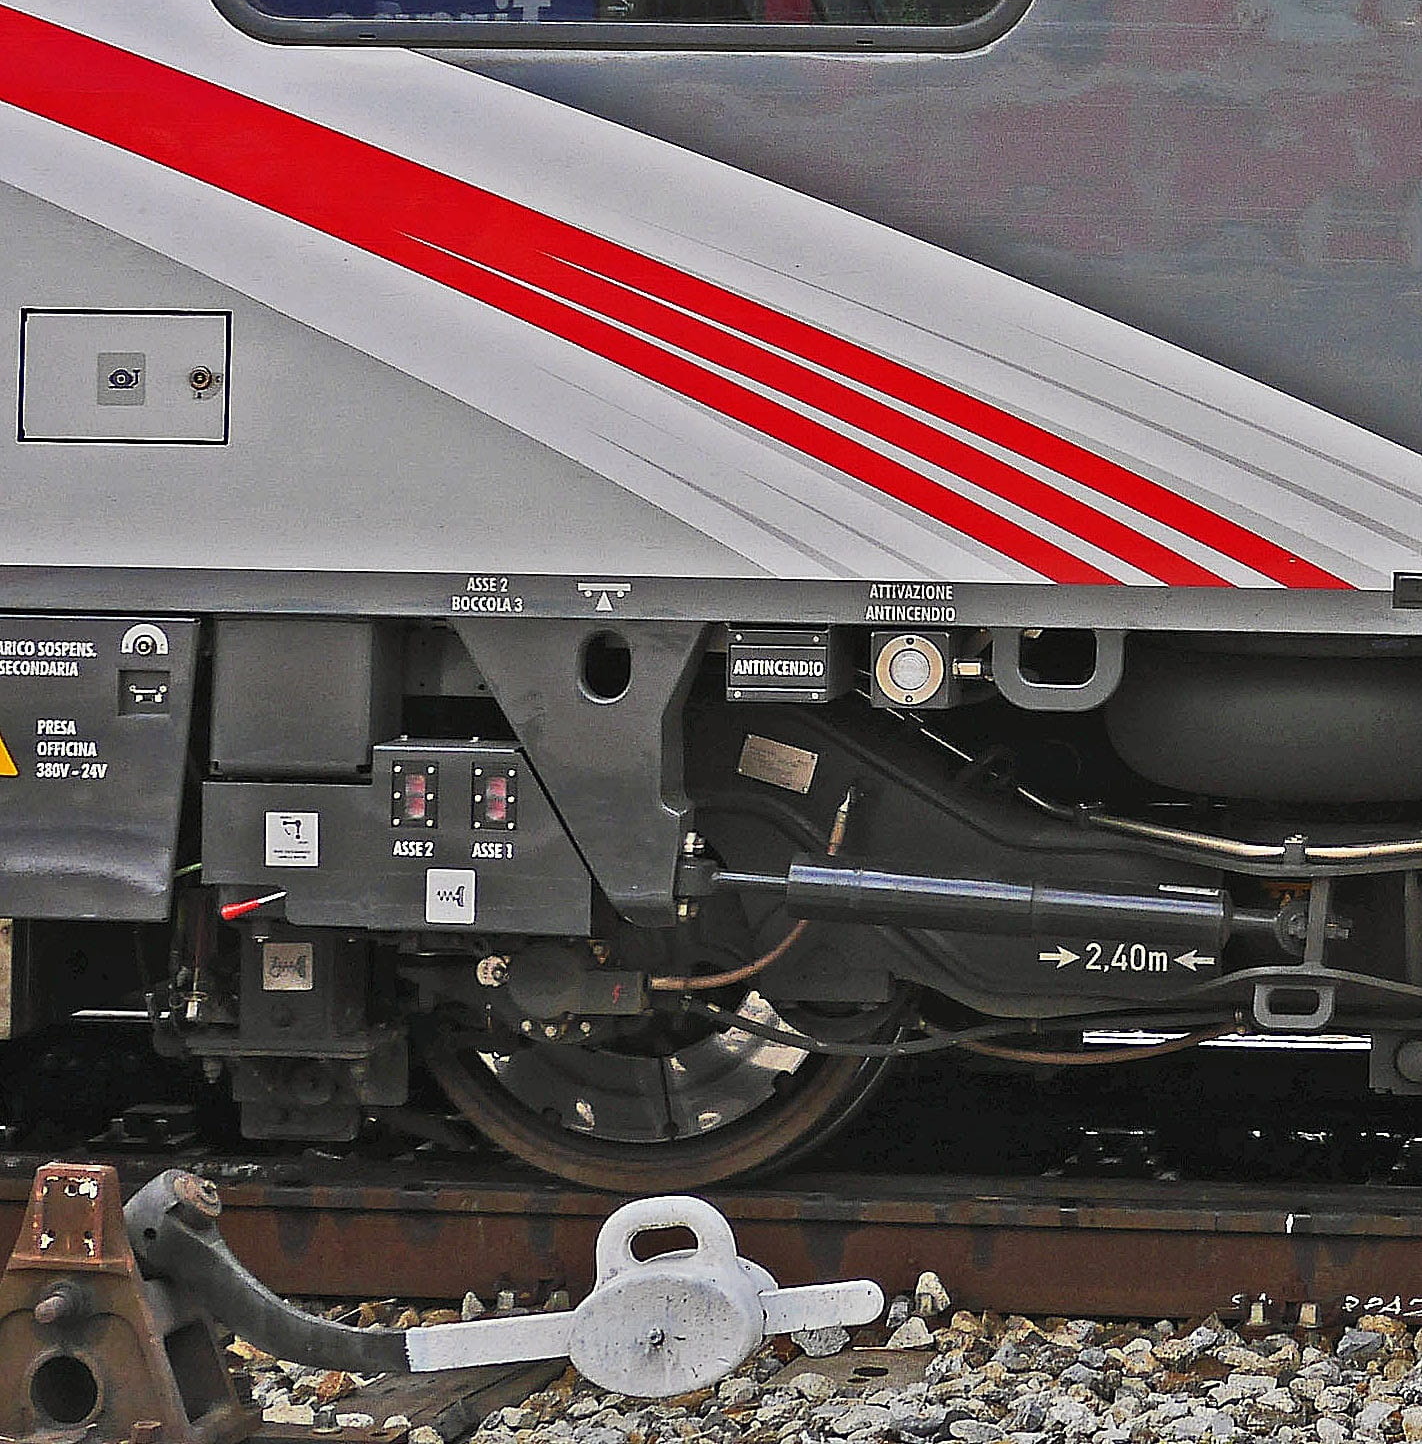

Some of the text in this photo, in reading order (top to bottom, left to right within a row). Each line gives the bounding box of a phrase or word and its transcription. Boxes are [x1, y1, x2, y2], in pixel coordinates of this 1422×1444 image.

[466, 577, 508, 593] ASSE 2
[869, 583, 954, 601] ATTIVAZIONE
[451, 595, 523, 613] BOCCOLA 3
[865, 605, 956, 622] ANTINCENDIO
[37, 641, 97, 658] SOSPENS.
[0, 660, 79, 677] SECONDARIA
[732, 659, 825, 677] ANTINCENDIO
[37, 719, 77, 736] PRESA
[37, 741, 97, 758] OFFICINA
[36, 762, 70, 779] 380V
[81, 763, 108, 779] 24V
[392, 840, 435, 857] ASSE 2
[471, 842, 514, 859] ASSE 1
[1085, 942, 1170, 974] 2,40m
